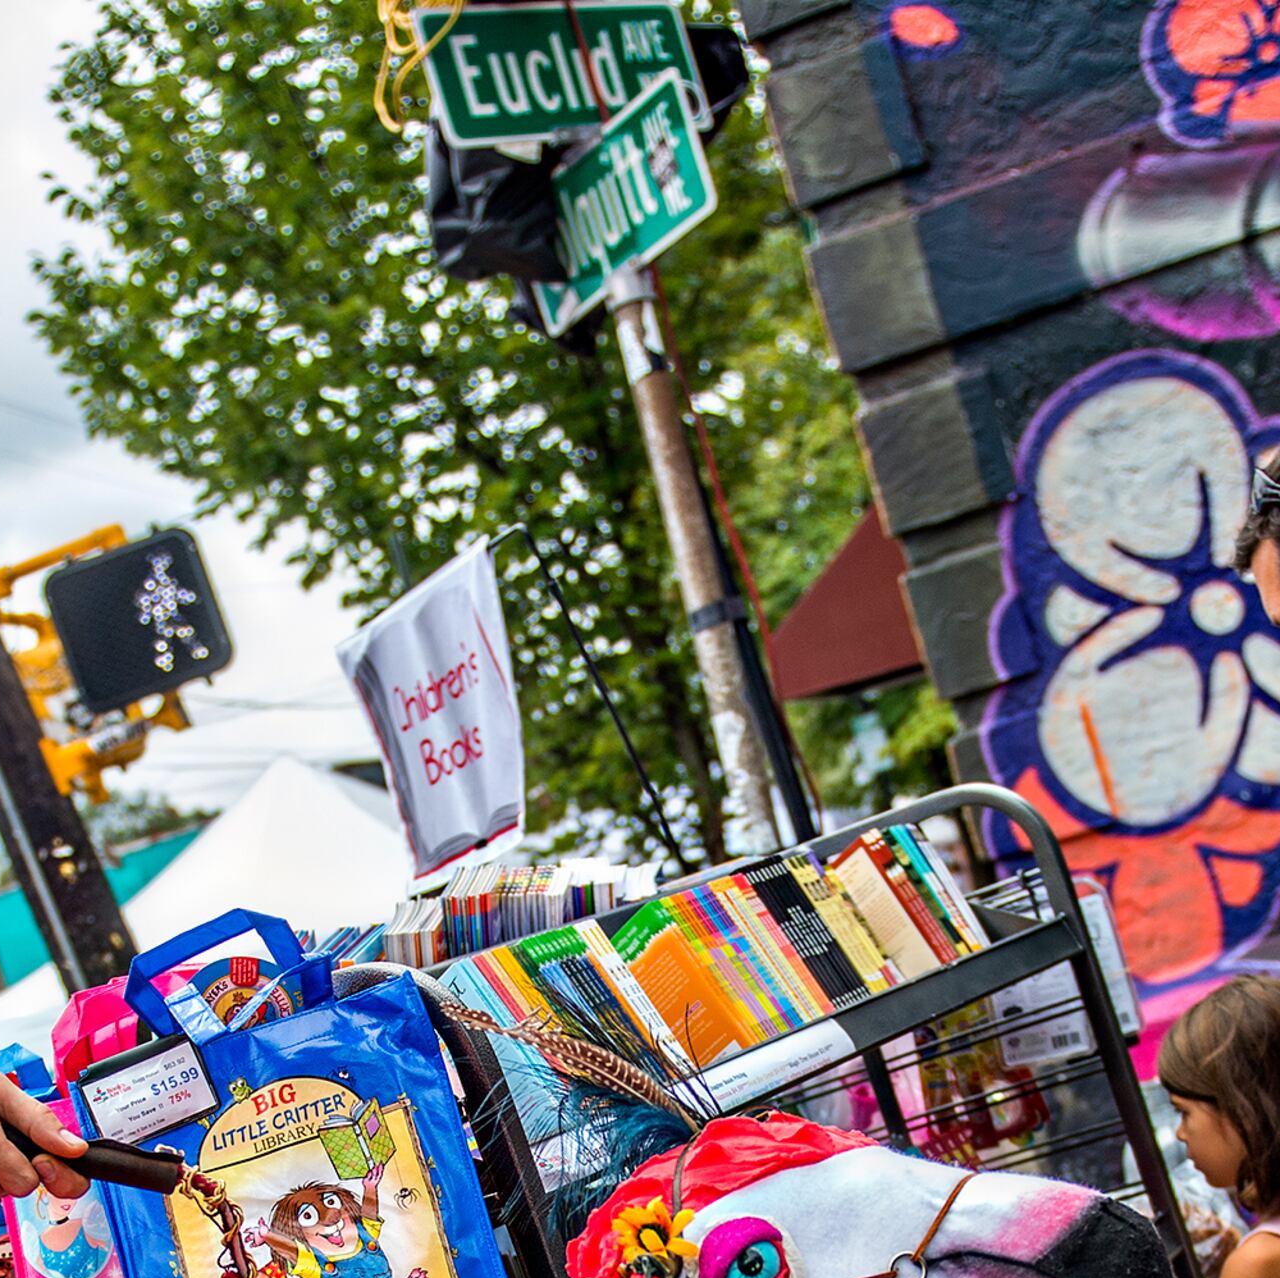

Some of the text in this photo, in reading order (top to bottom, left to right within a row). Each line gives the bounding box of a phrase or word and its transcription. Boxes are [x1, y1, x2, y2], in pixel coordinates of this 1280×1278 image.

[449, 31, 627, 118] Euclid
[420, 726, 483, 785] Books
[130, 1096, 146, 1107] Price
[150, 1067, 199, 1096] $15.99
[141, 1107, 157, 1117] Save
[168, 1089, 191, 1104] 75%
[251, 1083, 296, 1116] BIG
[213, 1119, 269, 1151] LITTLE
[253, 1122, 317, 1154] LIBRARY
